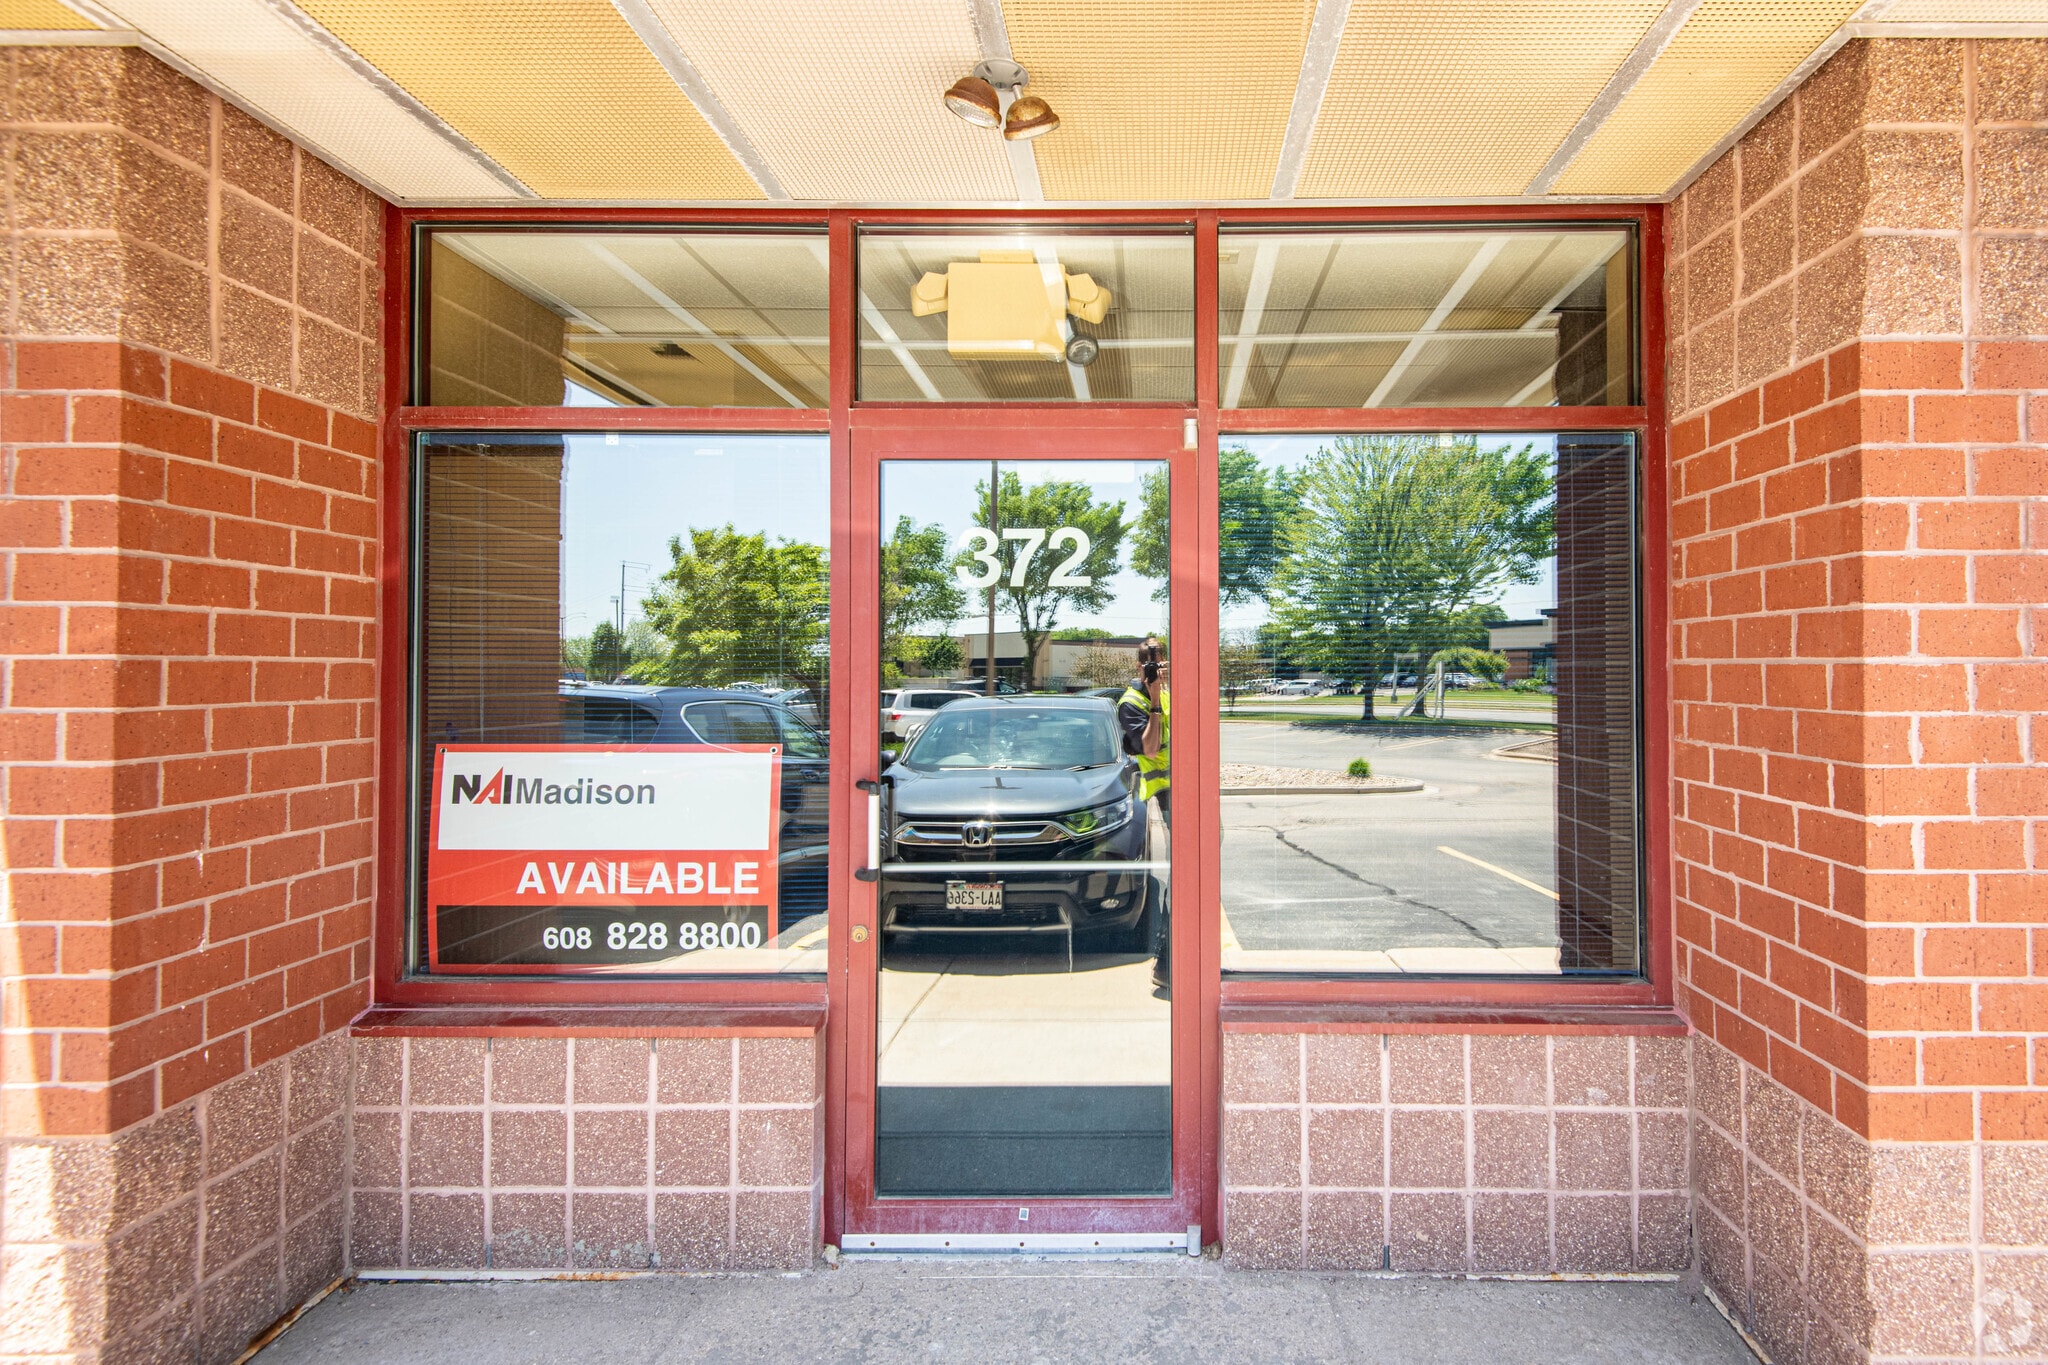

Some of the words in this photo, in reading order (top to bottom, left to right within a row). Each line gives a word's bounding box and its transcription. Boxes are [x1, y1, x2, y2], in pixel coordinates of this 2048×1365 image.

[956, 526, 1092, 589] 372
[451, 766, 513, 804] NAI
[516, 777, 656, 805] Madison
[516, 861, 760, 895] AVAILABLE
[542, 926, 592, 950] 608
[606, 921, 668, 950] 828
[678, 921, 761, 950] 8800
